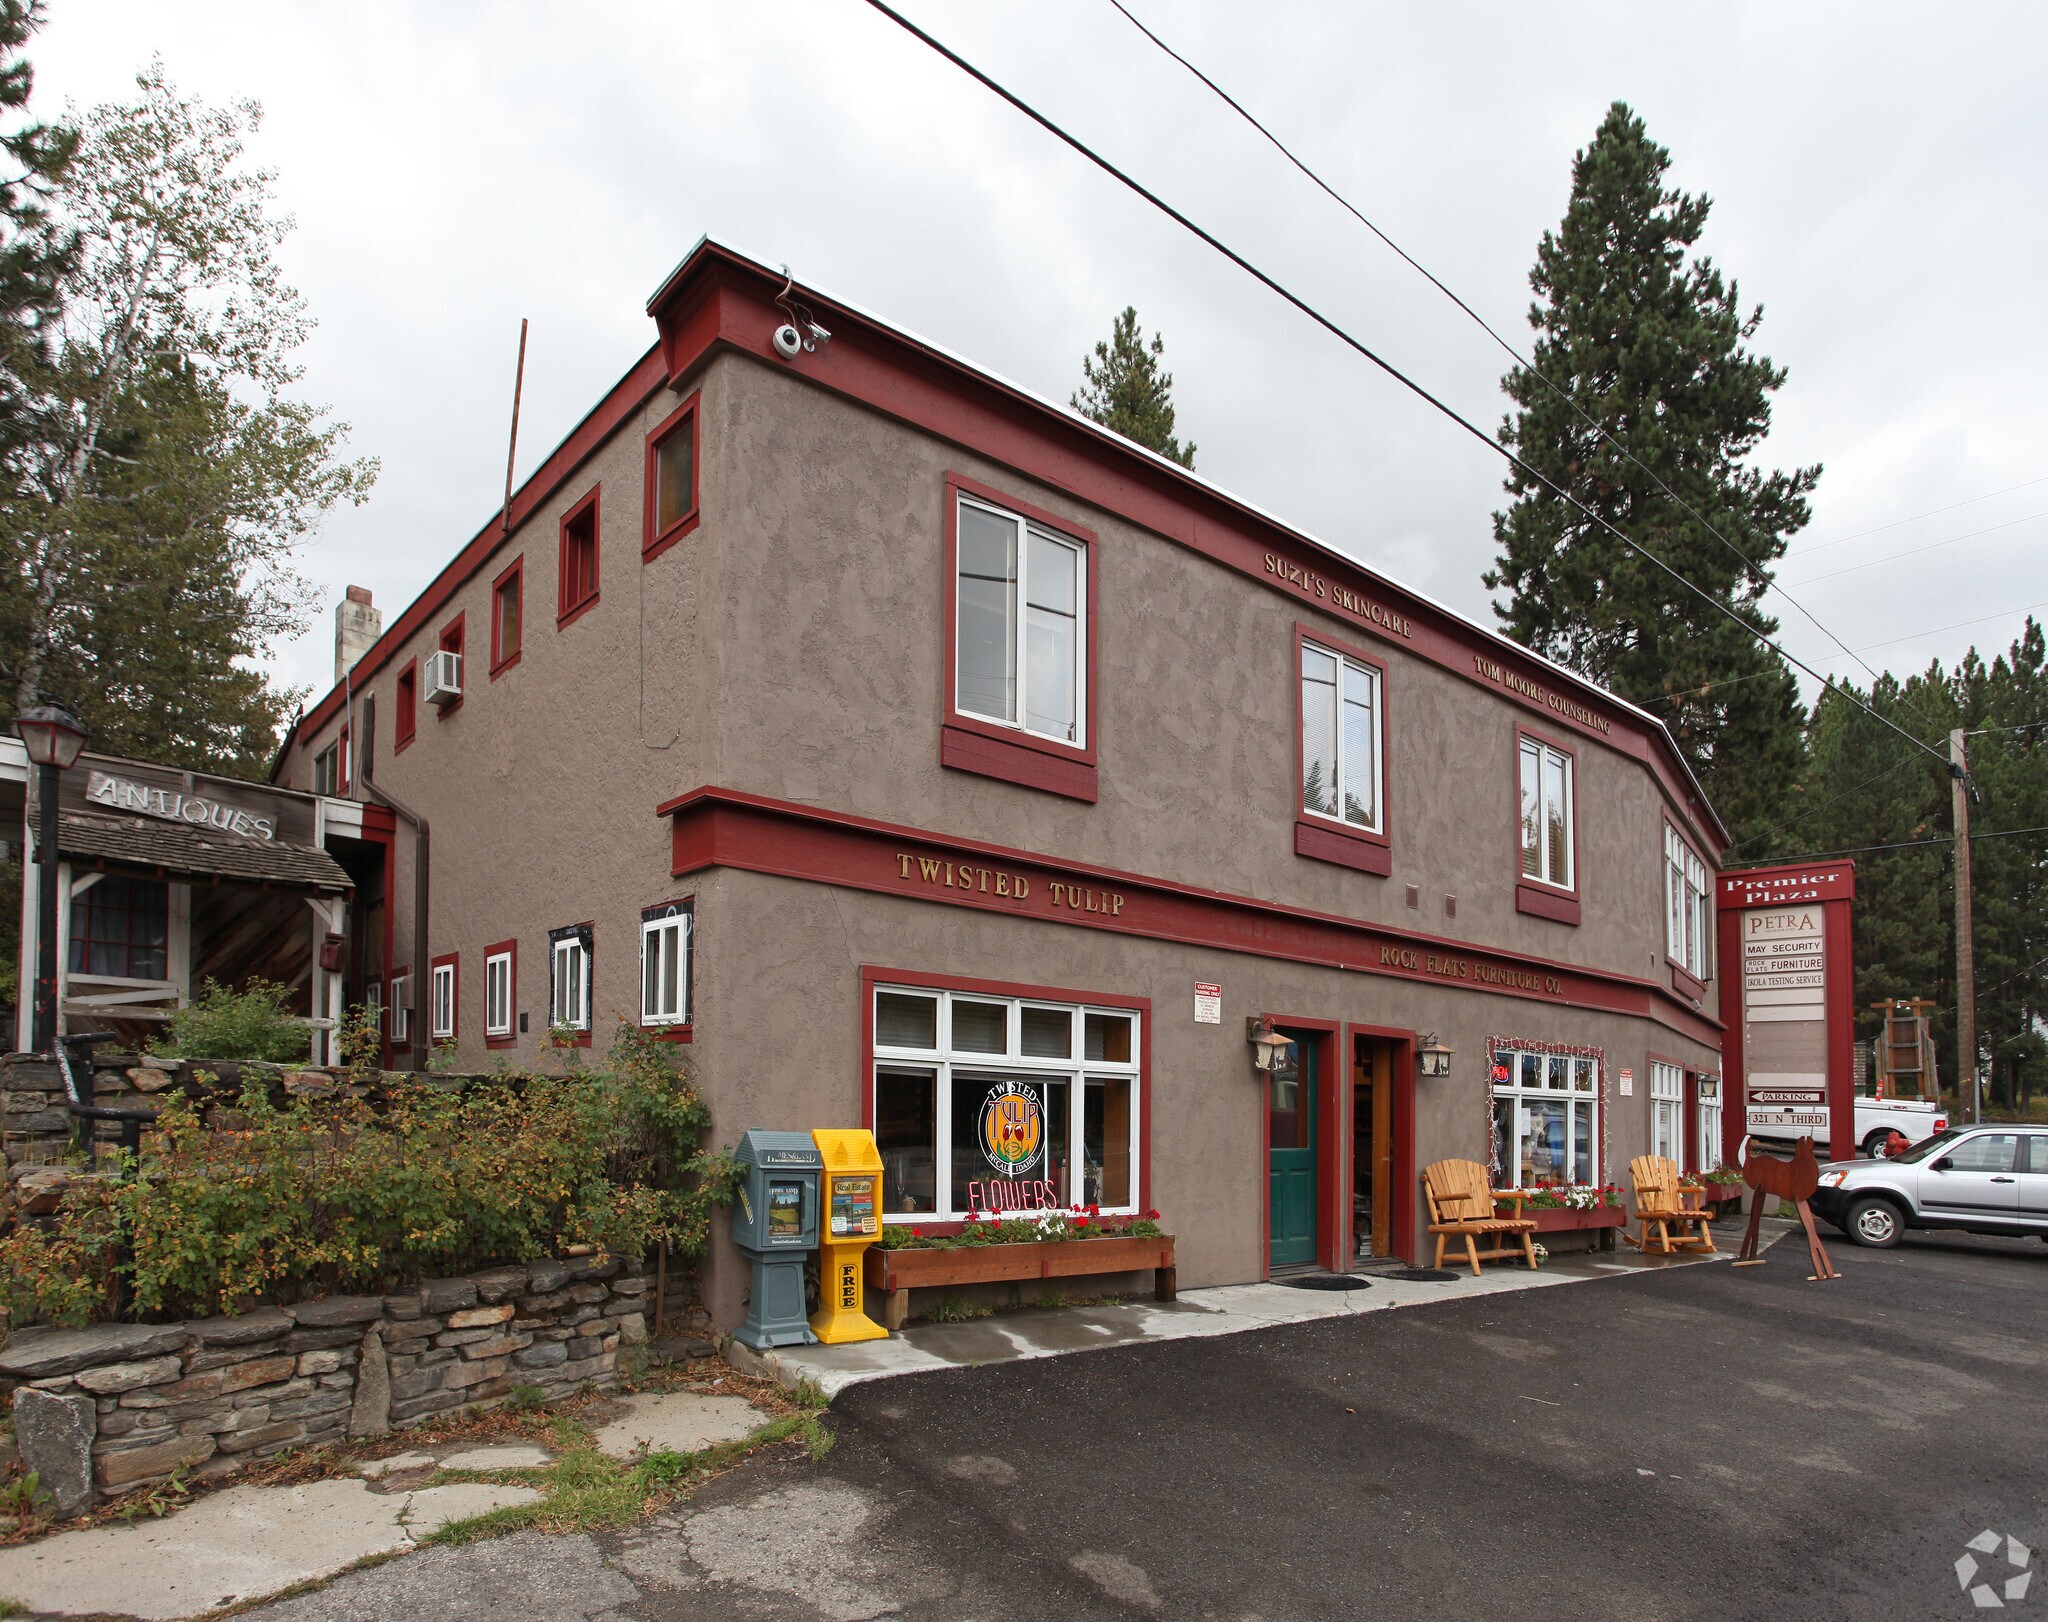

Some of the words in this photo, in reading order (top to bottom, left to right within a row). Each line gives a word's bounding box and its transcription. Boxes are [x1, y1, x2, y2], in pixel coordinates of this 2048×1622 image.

[1265, 553, 1325, 597] SUZI'S
[1332, 586, 1412, 638] SKINCARE
[1474, 656, 1501, 682] TOM
[1505, 671, 1545, 703] MOORE
[1548, 693, 1611, 735] COUNSELING
[94, 778, 273, 841] ANTIQUES
[897, 853, 1031, 900] TWISTED
[1050, 882, 1125, 916] TULIP
[1726, 873, 1840, 892] Premier
[1746, 890, 1818, 904] Plaza
[1750, 913, 1816, 934] PETRA
[1747, 945, 1767, 954] MAY
[1772, 942, 1821, 953] SECURITY
[1380, 946, 1418, 971] ROCK
[1426, 955, 1466, 979] FLATS
[1473, 963, 1540, 991] FURNITURE
[1546, 976, 1563, 995] CO.
[1771, 959, 1822, 970] FURNITURE
[1747, 977, 1767, 987] IKOLA
[1768, 975, 1795, 986] TESTING
[1796, 974, 1822, 984] SERVICE
[987, 1080, 1038, 1102] TWISTED
[1762, 1093, 1811, 1101] PARKING
[988, 1101, 1038, 1140] TULIP
[1752, 1114, 1768, 1124] 321
[1775, 1115, 1783, 1124] N
[1790, 1114, 1823, 1124] THIRD
[1015, 1156, 1037, 1172] IDAHO
[836, 1183, 851, 1192] Real
[852, 1182, 871, 1192] Estate
[968, 1180, 1058, 1211] FLOWERS
[842, 1265, 856, 1308] FREE
